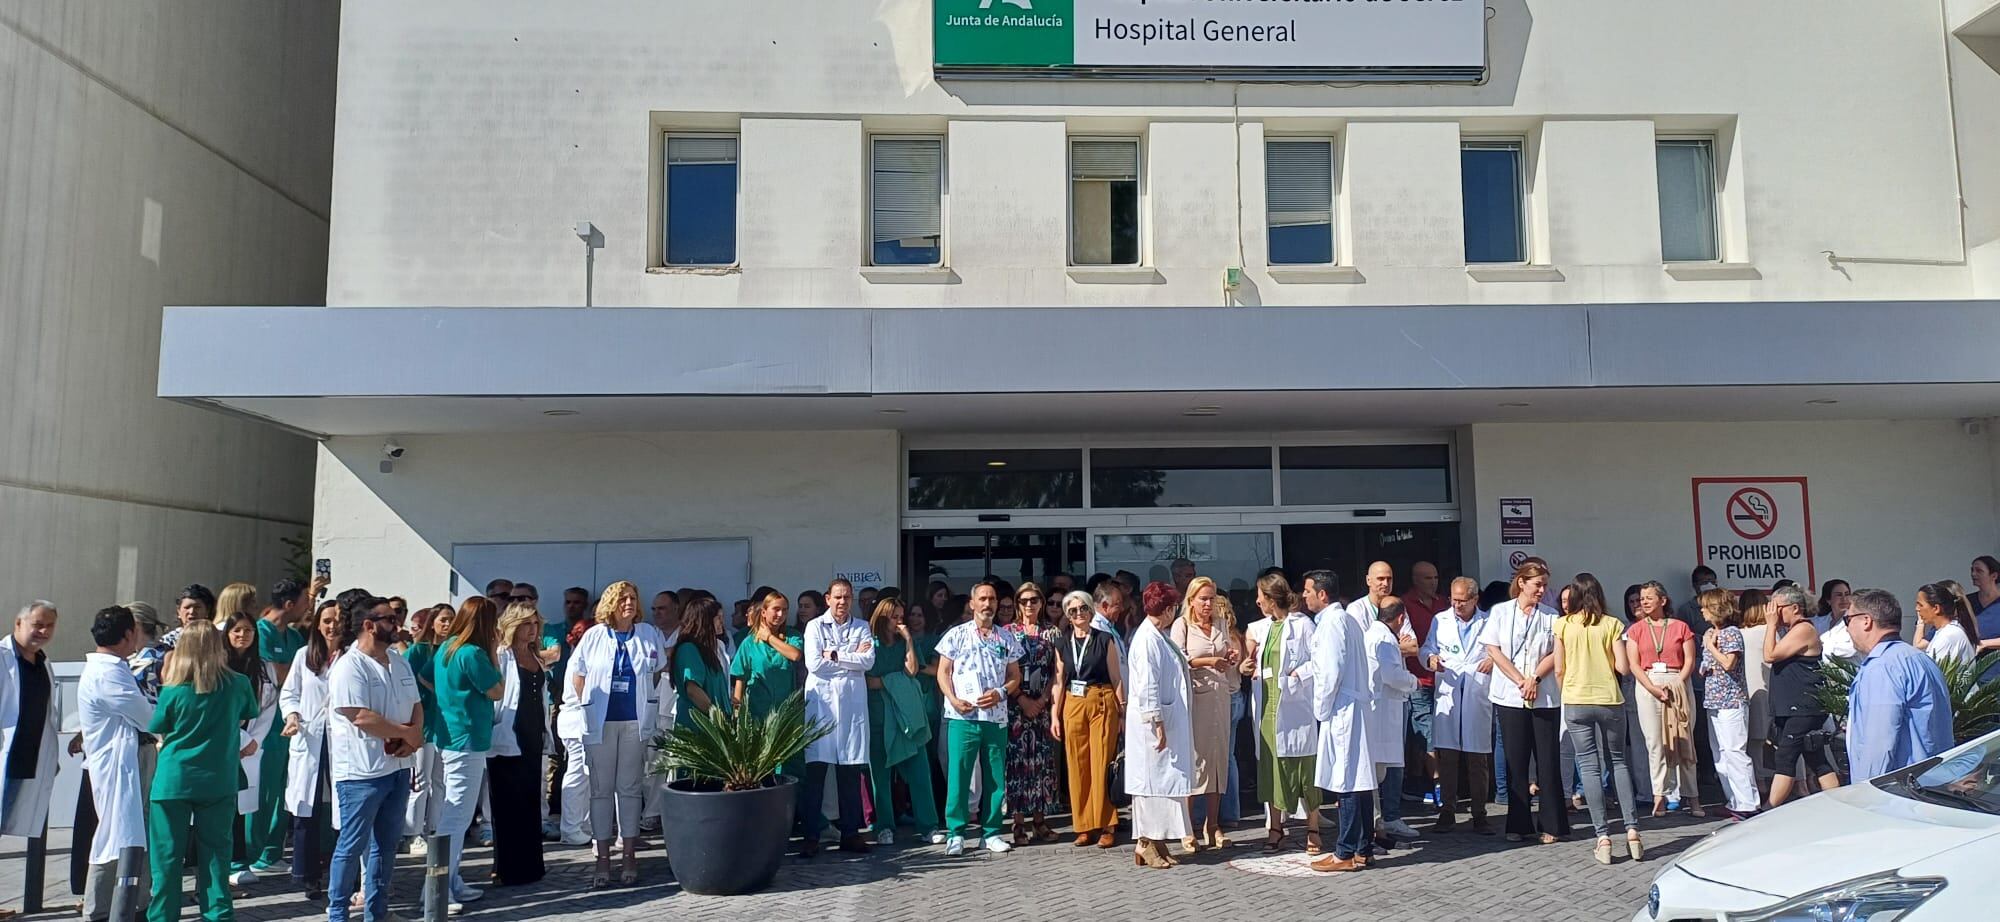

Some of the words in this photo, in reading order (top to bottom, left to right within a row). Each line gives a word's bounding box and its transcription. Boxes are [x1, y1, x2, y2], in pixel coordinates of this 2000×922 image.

[945, 14, 981, 27] Junta
[983, 14, 1000, 27] de
[1001, 13, 1063, 27] Andalucía
[1095, 16, 1196, 46] Hospital
[1203, 17, 1296, 43] General
[1707, 544, 1801, 561] PROHIBIDO
[1726, 563, 1787, 579] FUMAR
